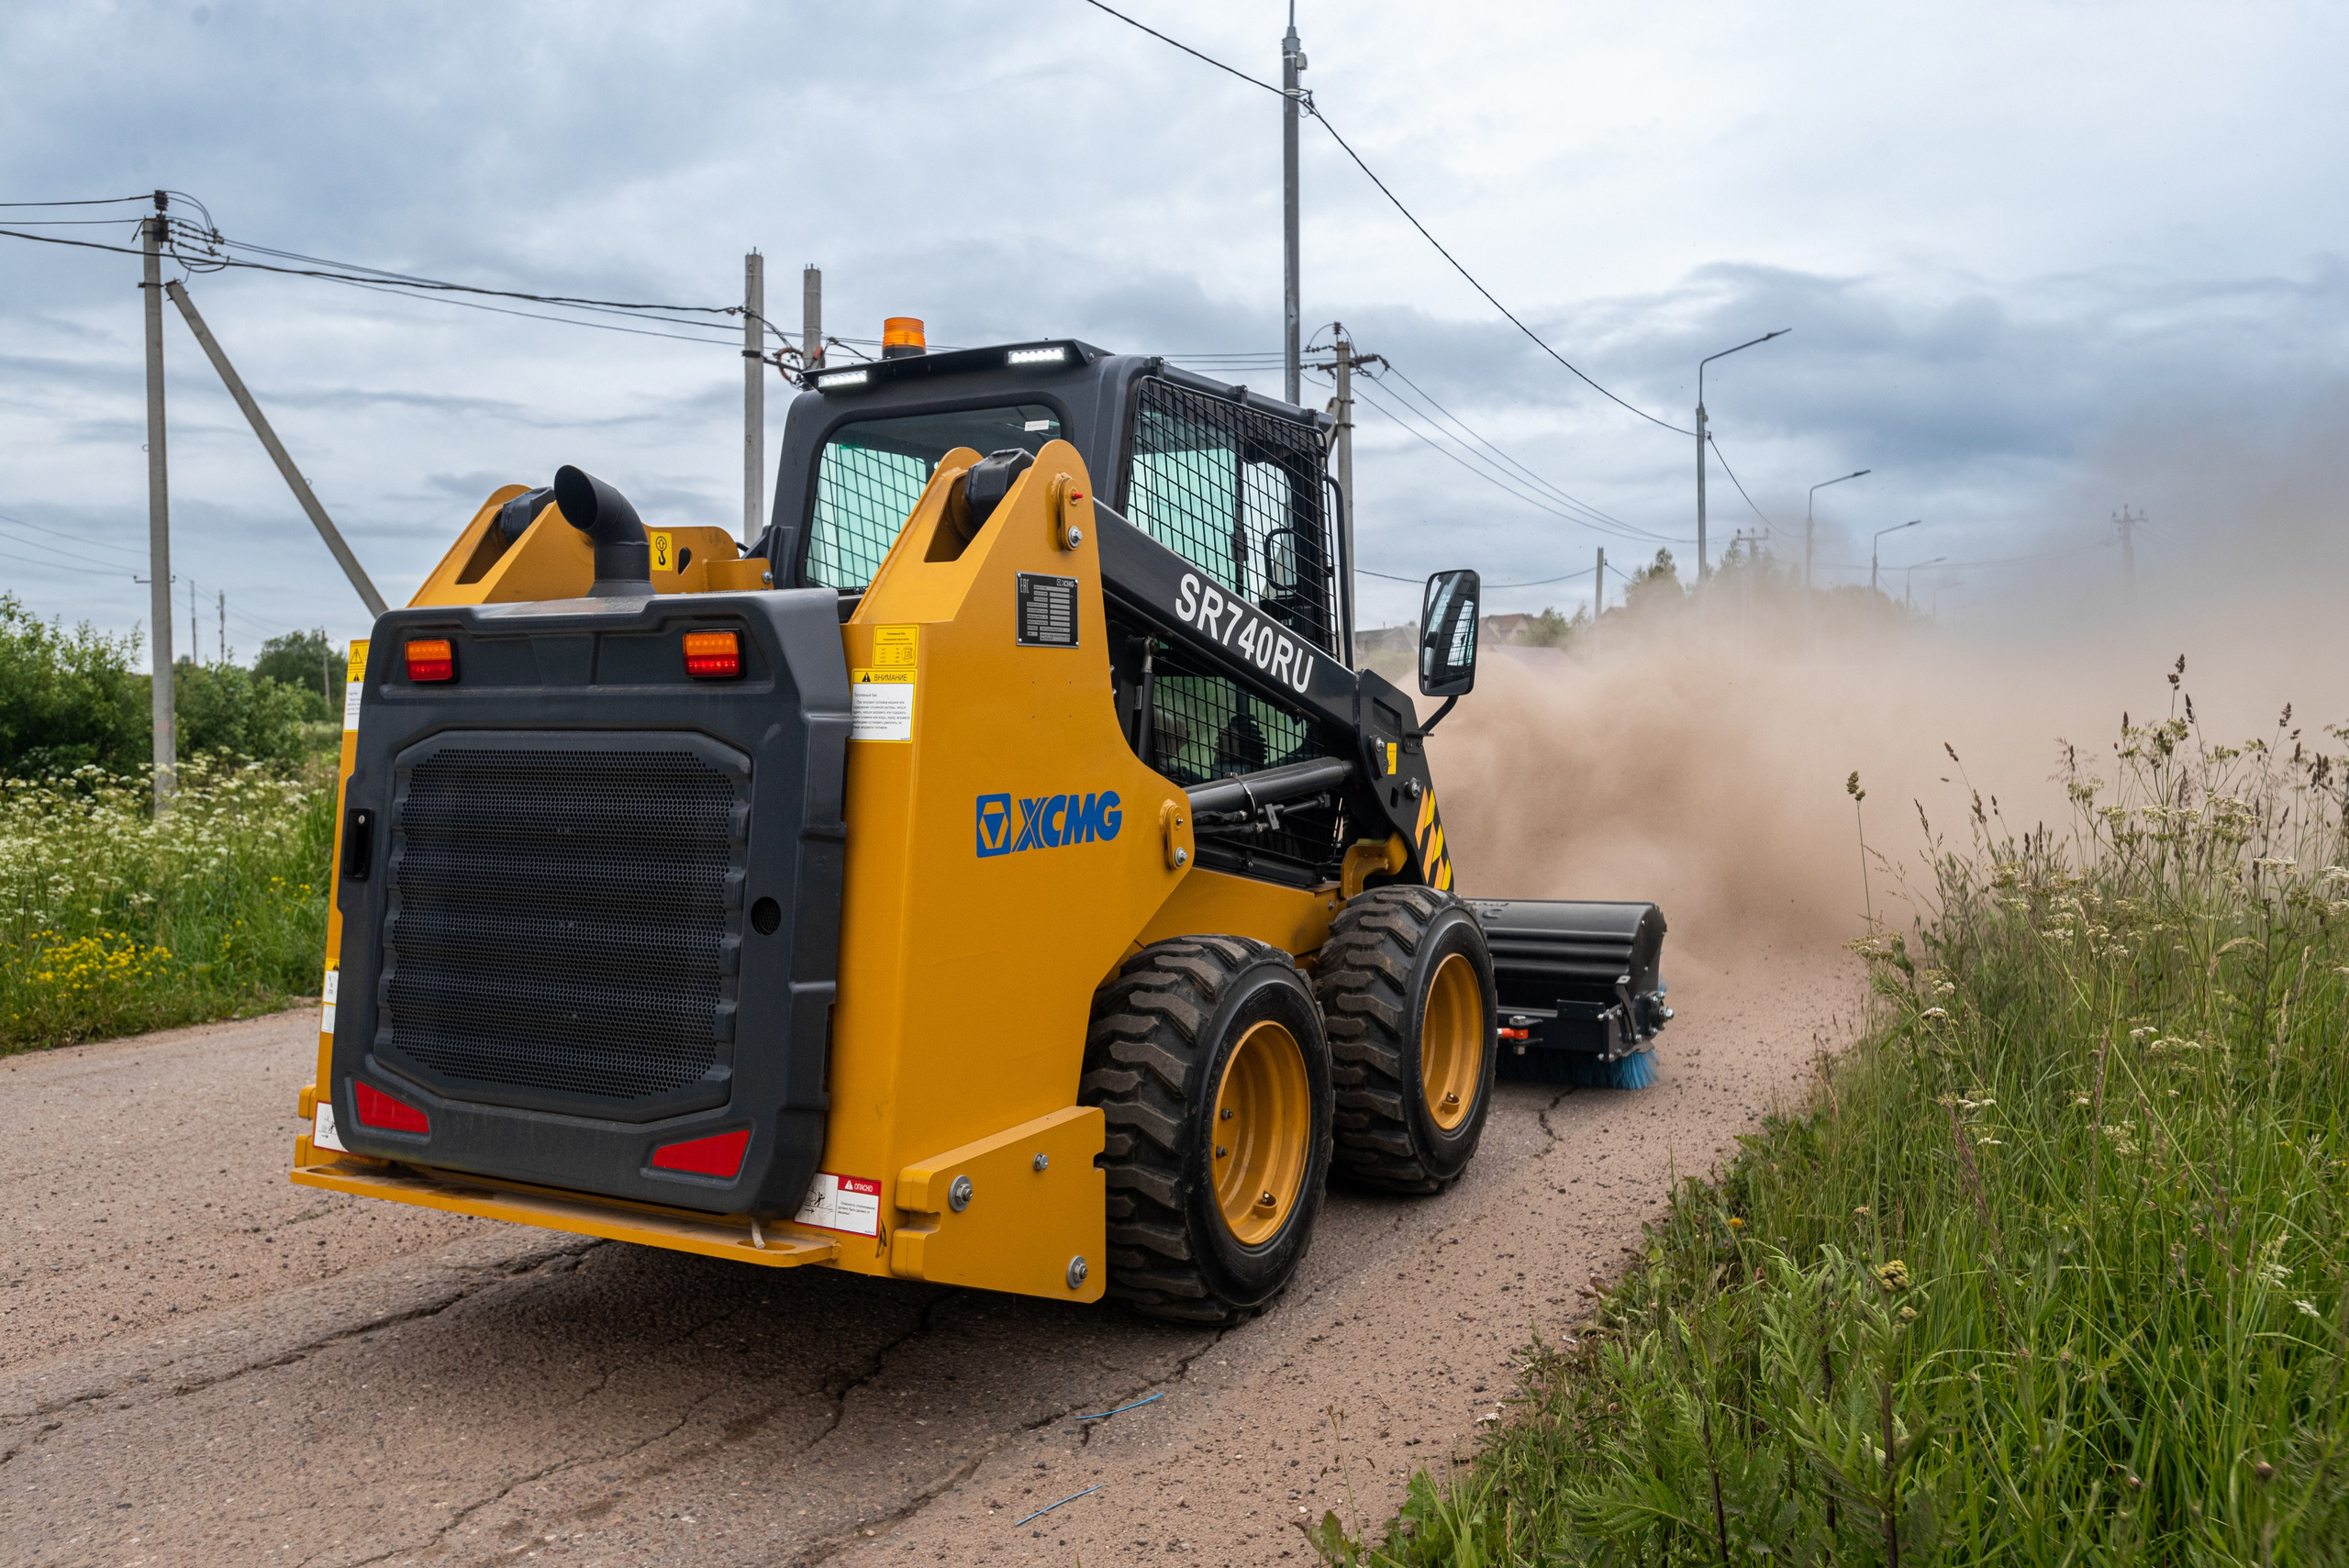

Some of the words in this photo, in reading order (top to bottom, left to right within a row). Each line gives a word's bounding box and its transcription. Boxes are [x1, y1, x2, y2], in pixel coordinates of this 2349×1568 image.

[1175, 573, 1314, 694] SR740RU
[874, 673, 907, 682] ВНИМАНИЕ
[1011, 790, 1122, 852] XCMG
[853, 1183, 874, 1193] ОПАСНО
